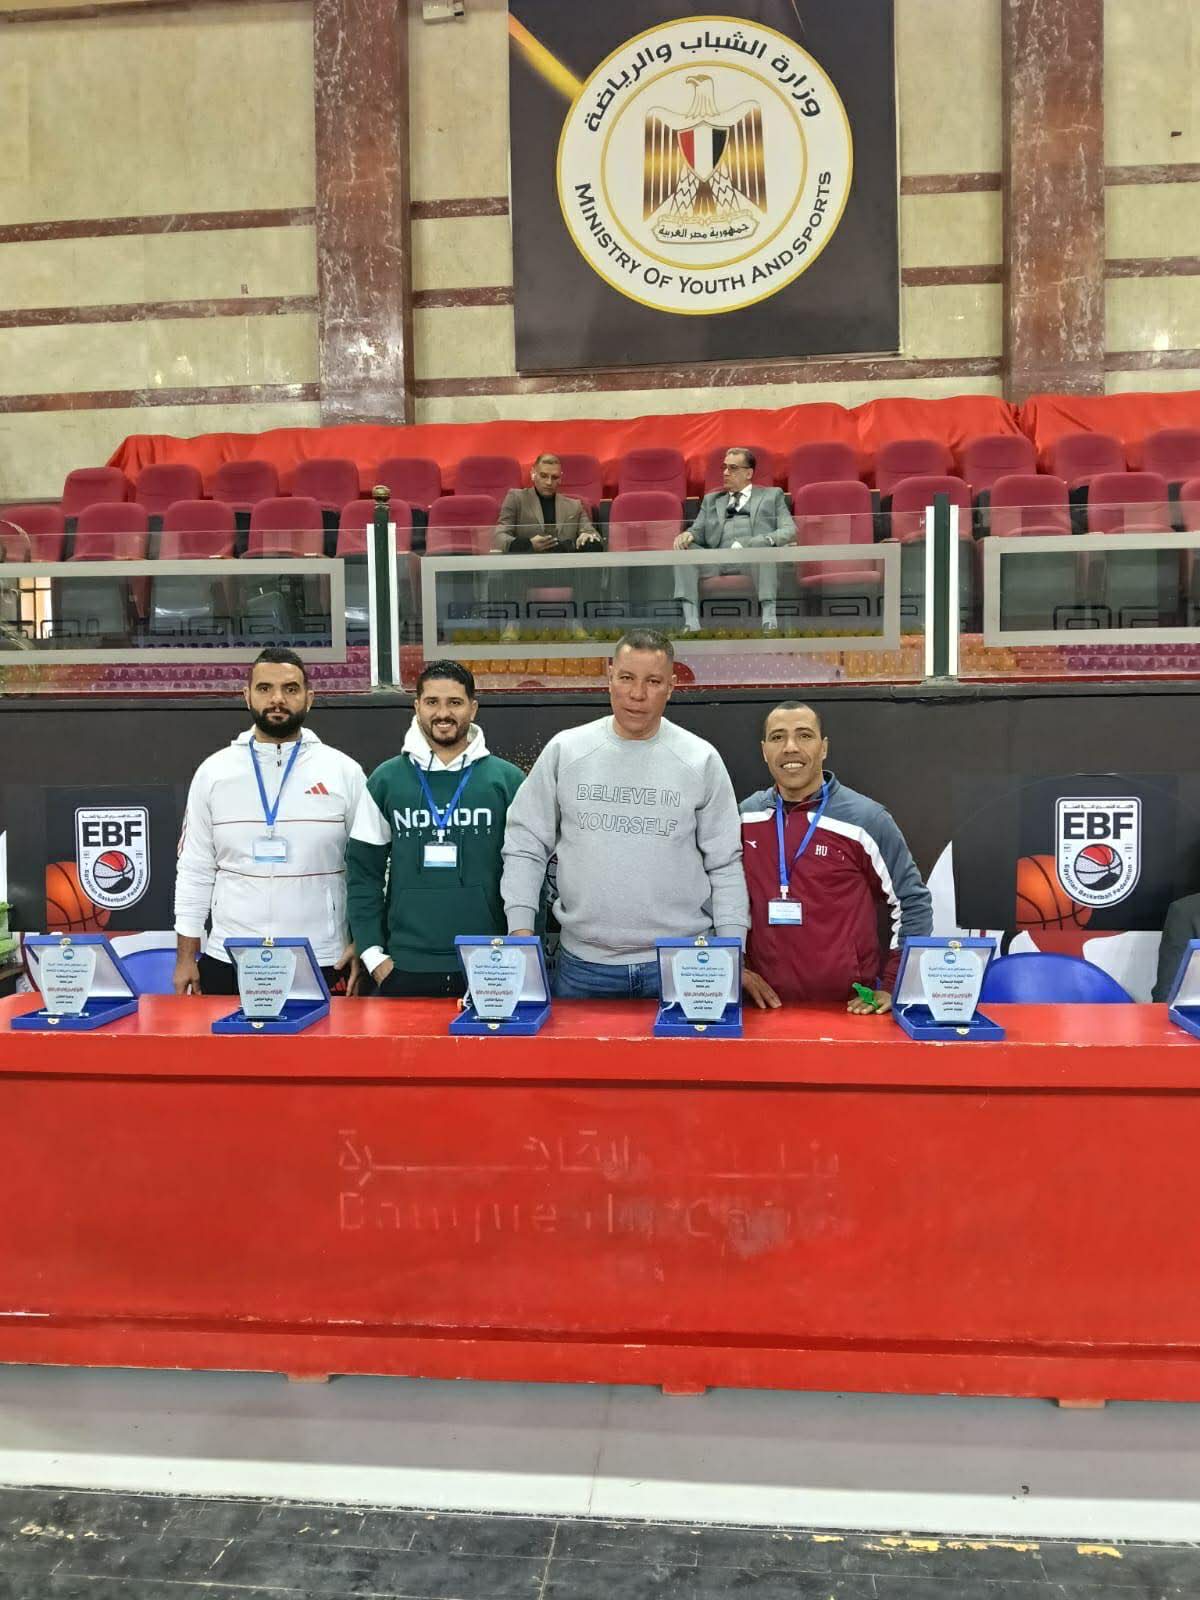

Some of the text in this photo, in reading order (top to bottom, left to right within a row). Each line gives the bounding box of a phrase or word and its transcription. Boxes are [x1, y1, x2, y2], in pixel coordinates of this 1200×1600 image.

[584, 31, 821, 132] وزارة الشباب والرياضة
[659, 223, 750, 239] جمهورية مصر العربية
[576, 784, 681, 807] BELIEVE IN
[82, 821, 142, 847] EBF
[576, 812, 679, 836] YOURSELF
[1063, 812, 1134, 839] EBF
